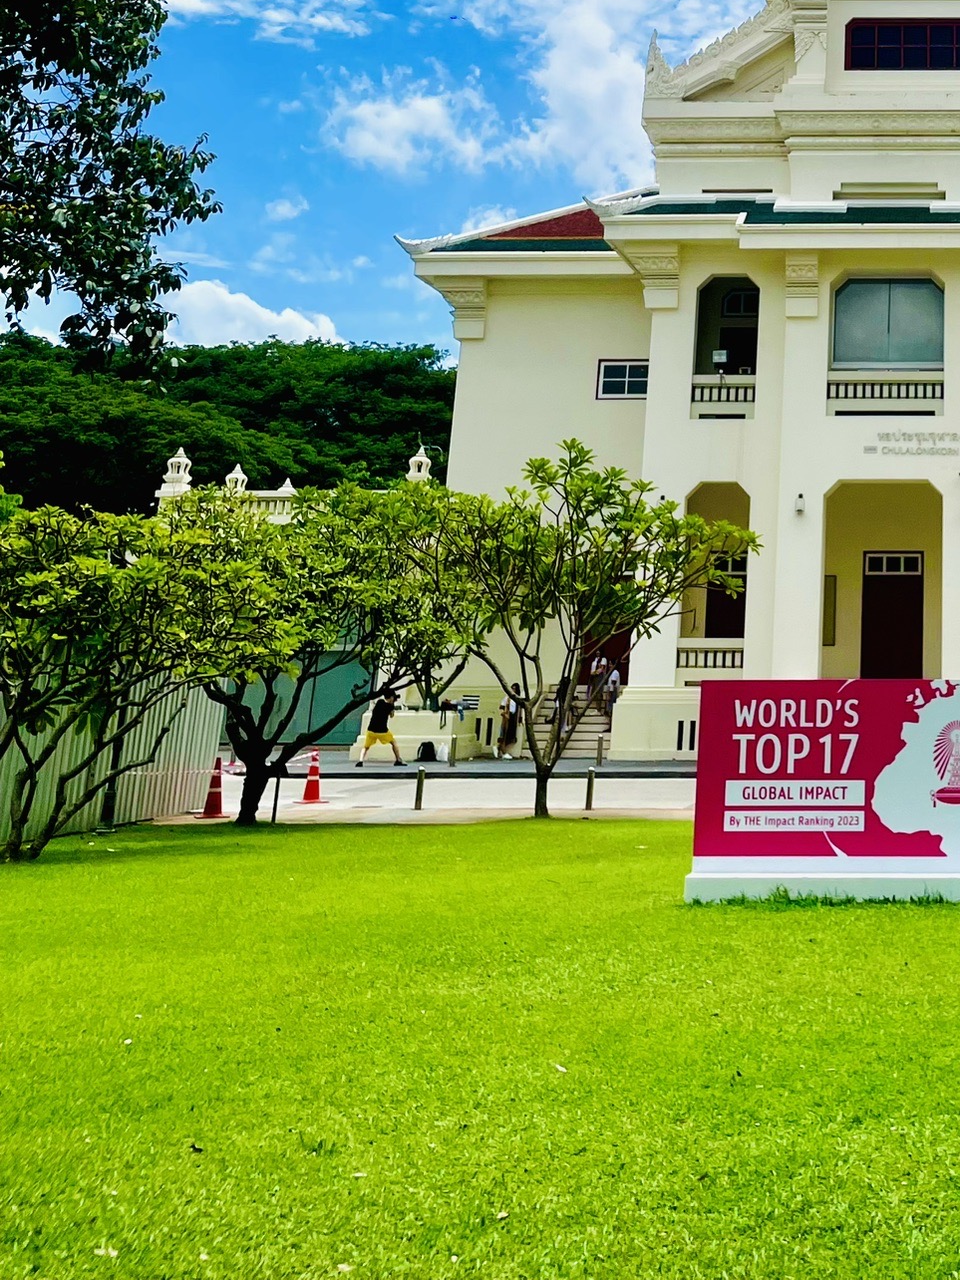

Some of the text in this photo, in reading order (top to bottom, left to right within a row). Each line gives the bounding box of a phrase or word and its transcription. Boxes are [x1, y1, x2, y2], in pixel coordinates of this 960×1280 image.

[881, 446, 959, 456] CHULALONGKORN
[735, 699, 859, 728] WORLD'S
[733, 734, 859, 775] TOP 17
[742, 786, 848, 800] GLOBAL IMPACT
[729, 816, 860, 828] By THE Impact Ranking 2023
